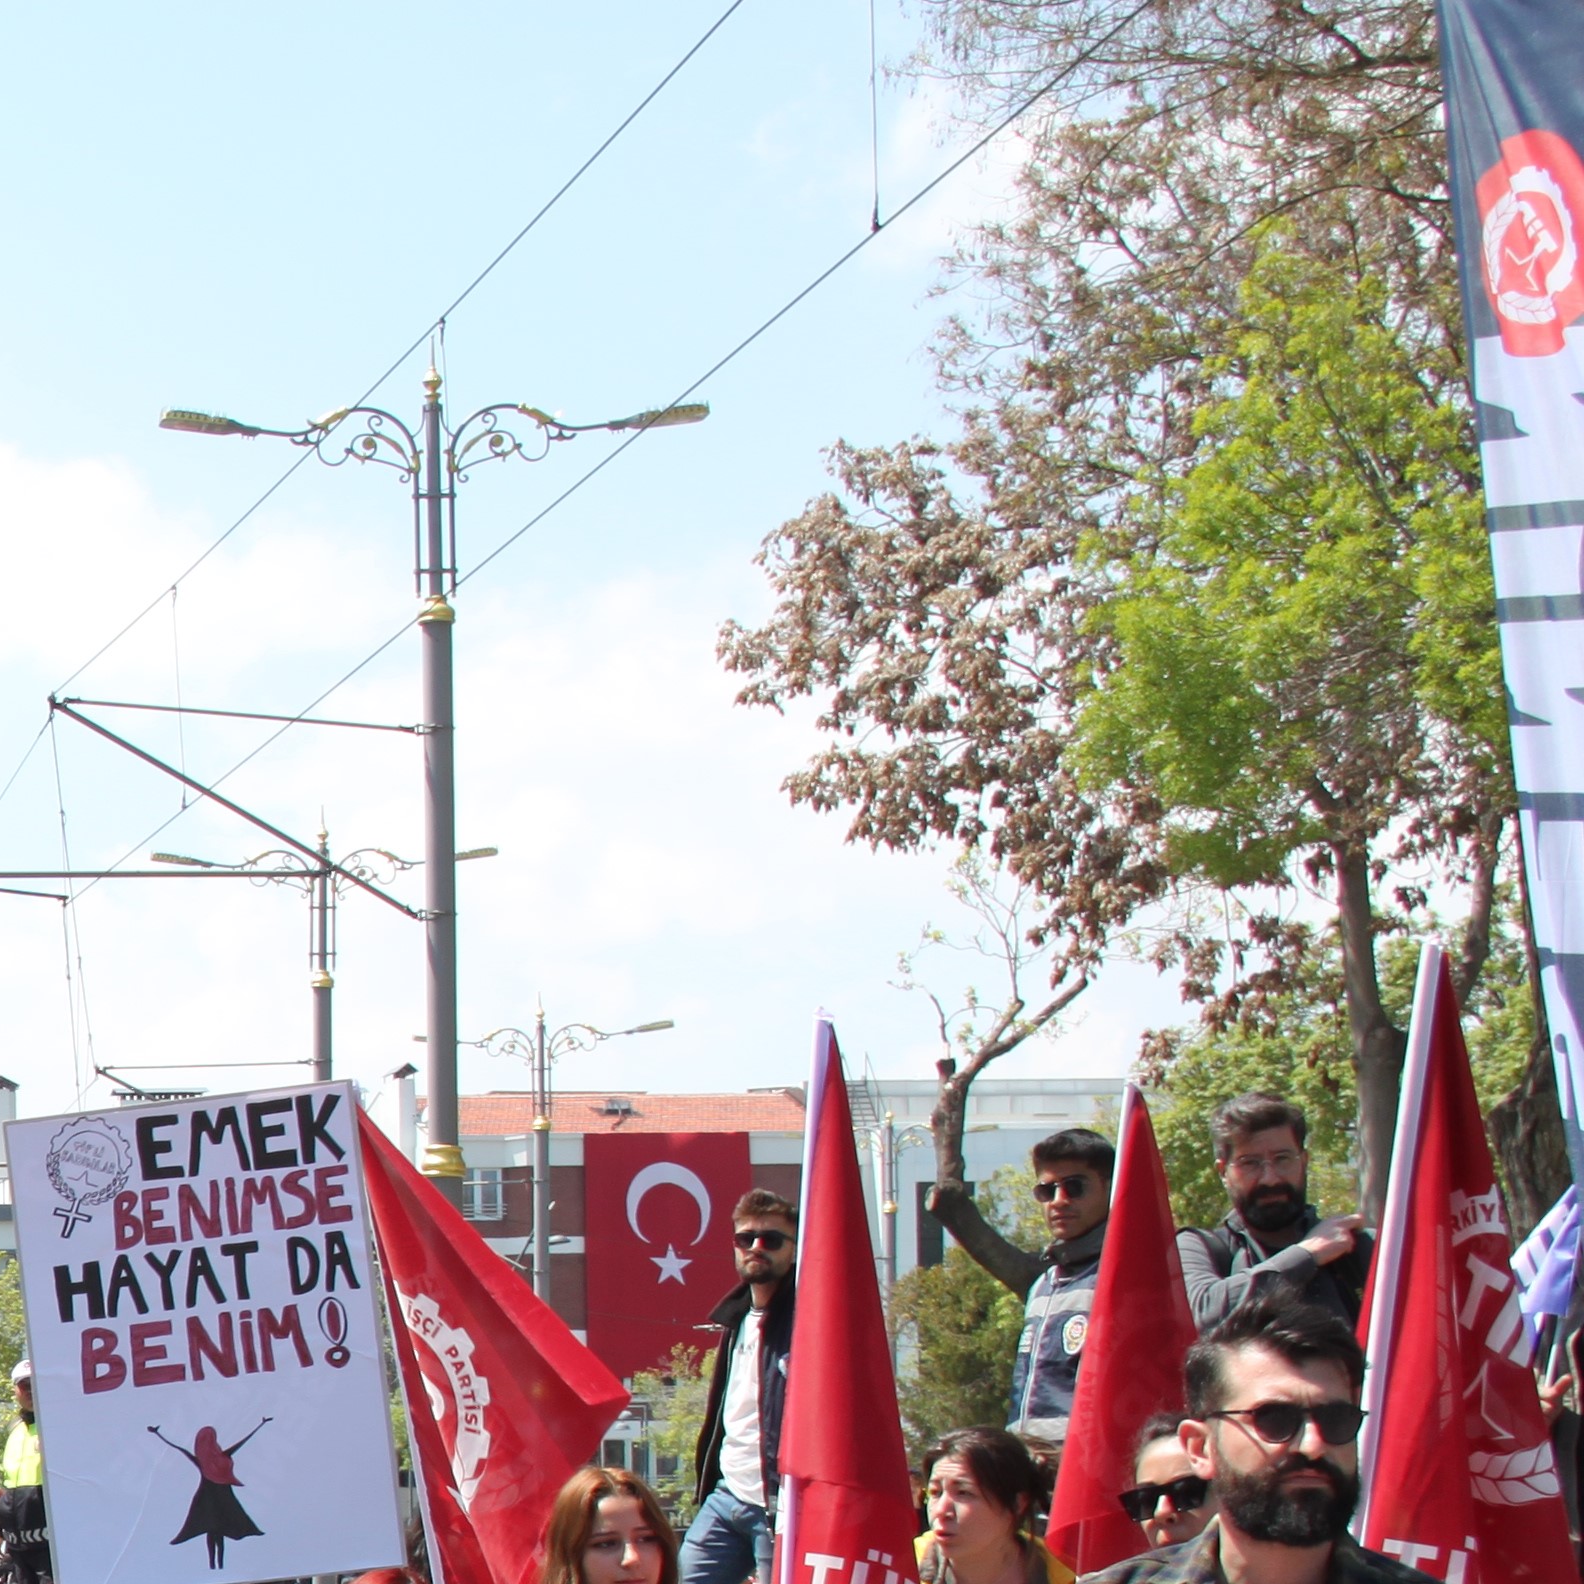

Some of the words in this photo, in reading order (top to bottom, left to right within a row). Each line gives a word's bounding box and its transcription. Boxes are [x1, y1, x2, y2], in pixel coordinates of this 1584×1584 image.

[136, 1094, 346, 1180] EMEK
[53, 1241, 259, 1322] HAYAT
[286, 1230, 361, 1295] DA
[406, 1301, 443, 1339] İŞÇİ
[444, 1345, 482, 1436] PARTİSİ
